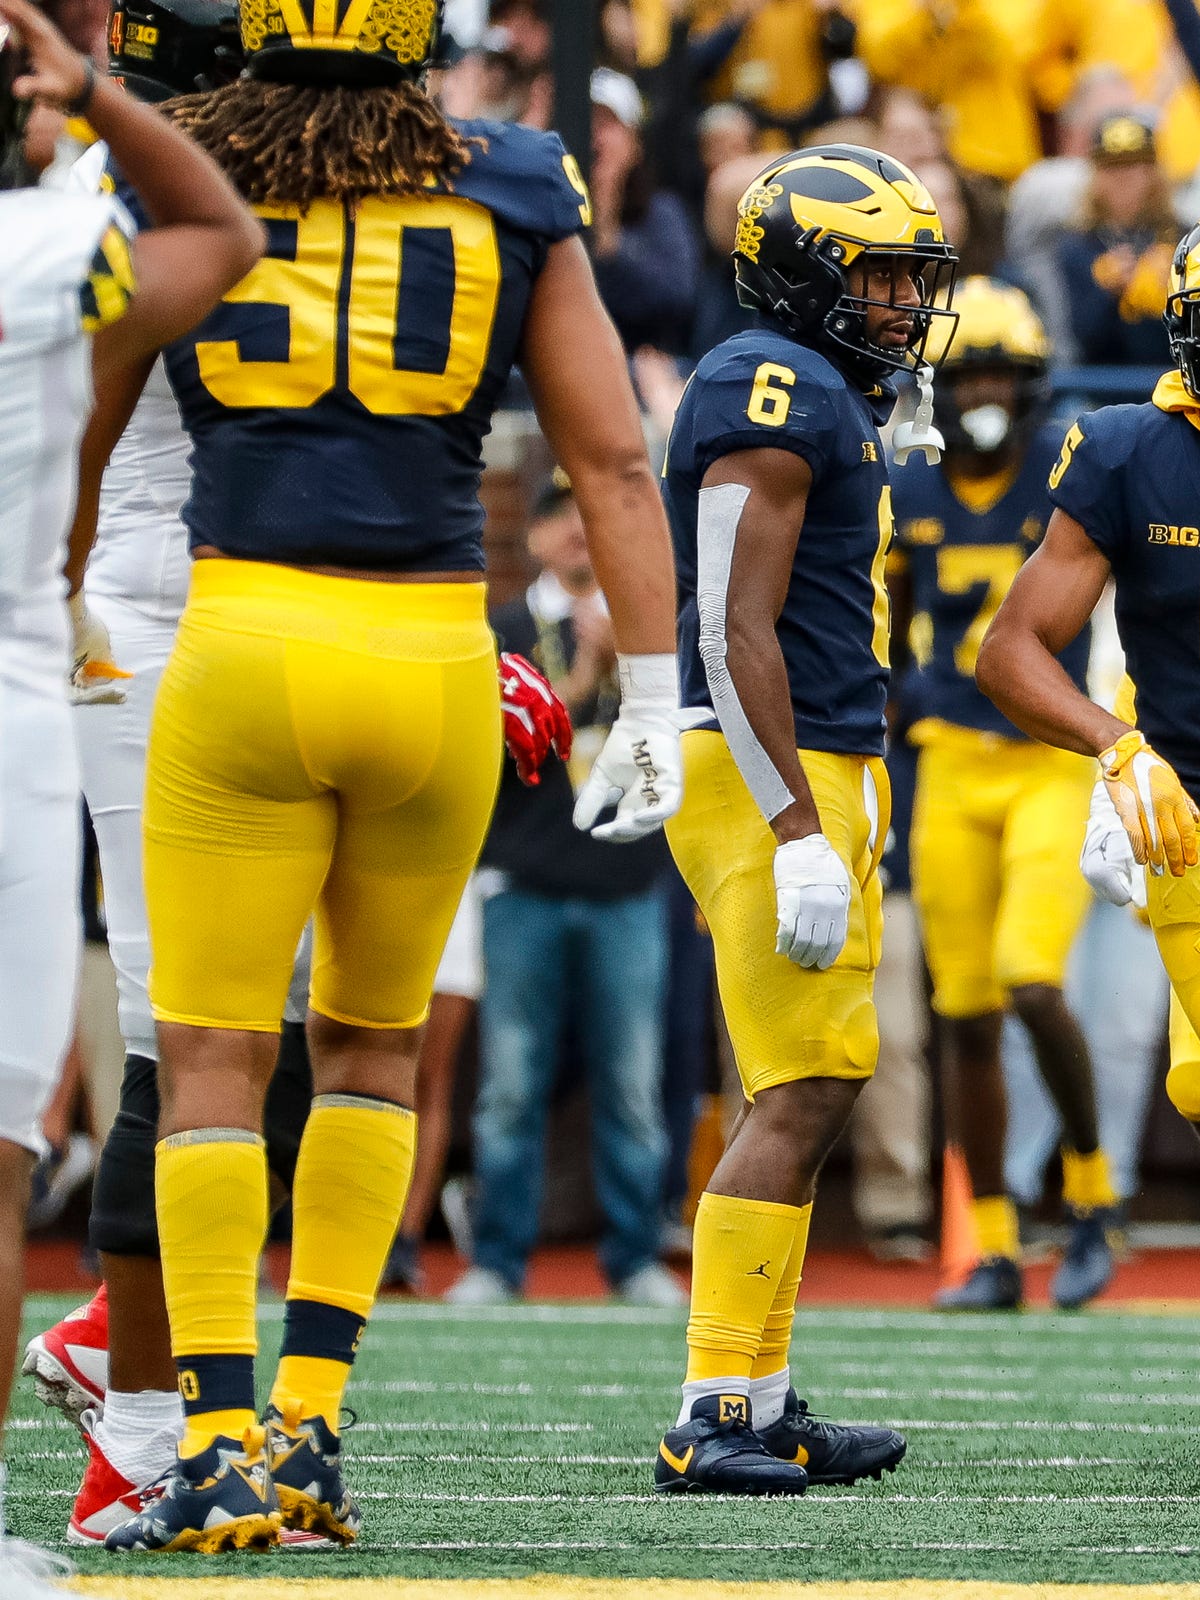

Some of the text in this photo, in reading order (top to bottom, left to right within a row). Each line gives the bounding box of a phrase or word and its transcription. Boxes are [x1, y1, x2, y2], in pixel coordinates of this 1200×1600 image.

[267, 16, 283, 33] 90
[747, 362, 796, 427] 6
[723, 1401, 744, 1417] M
